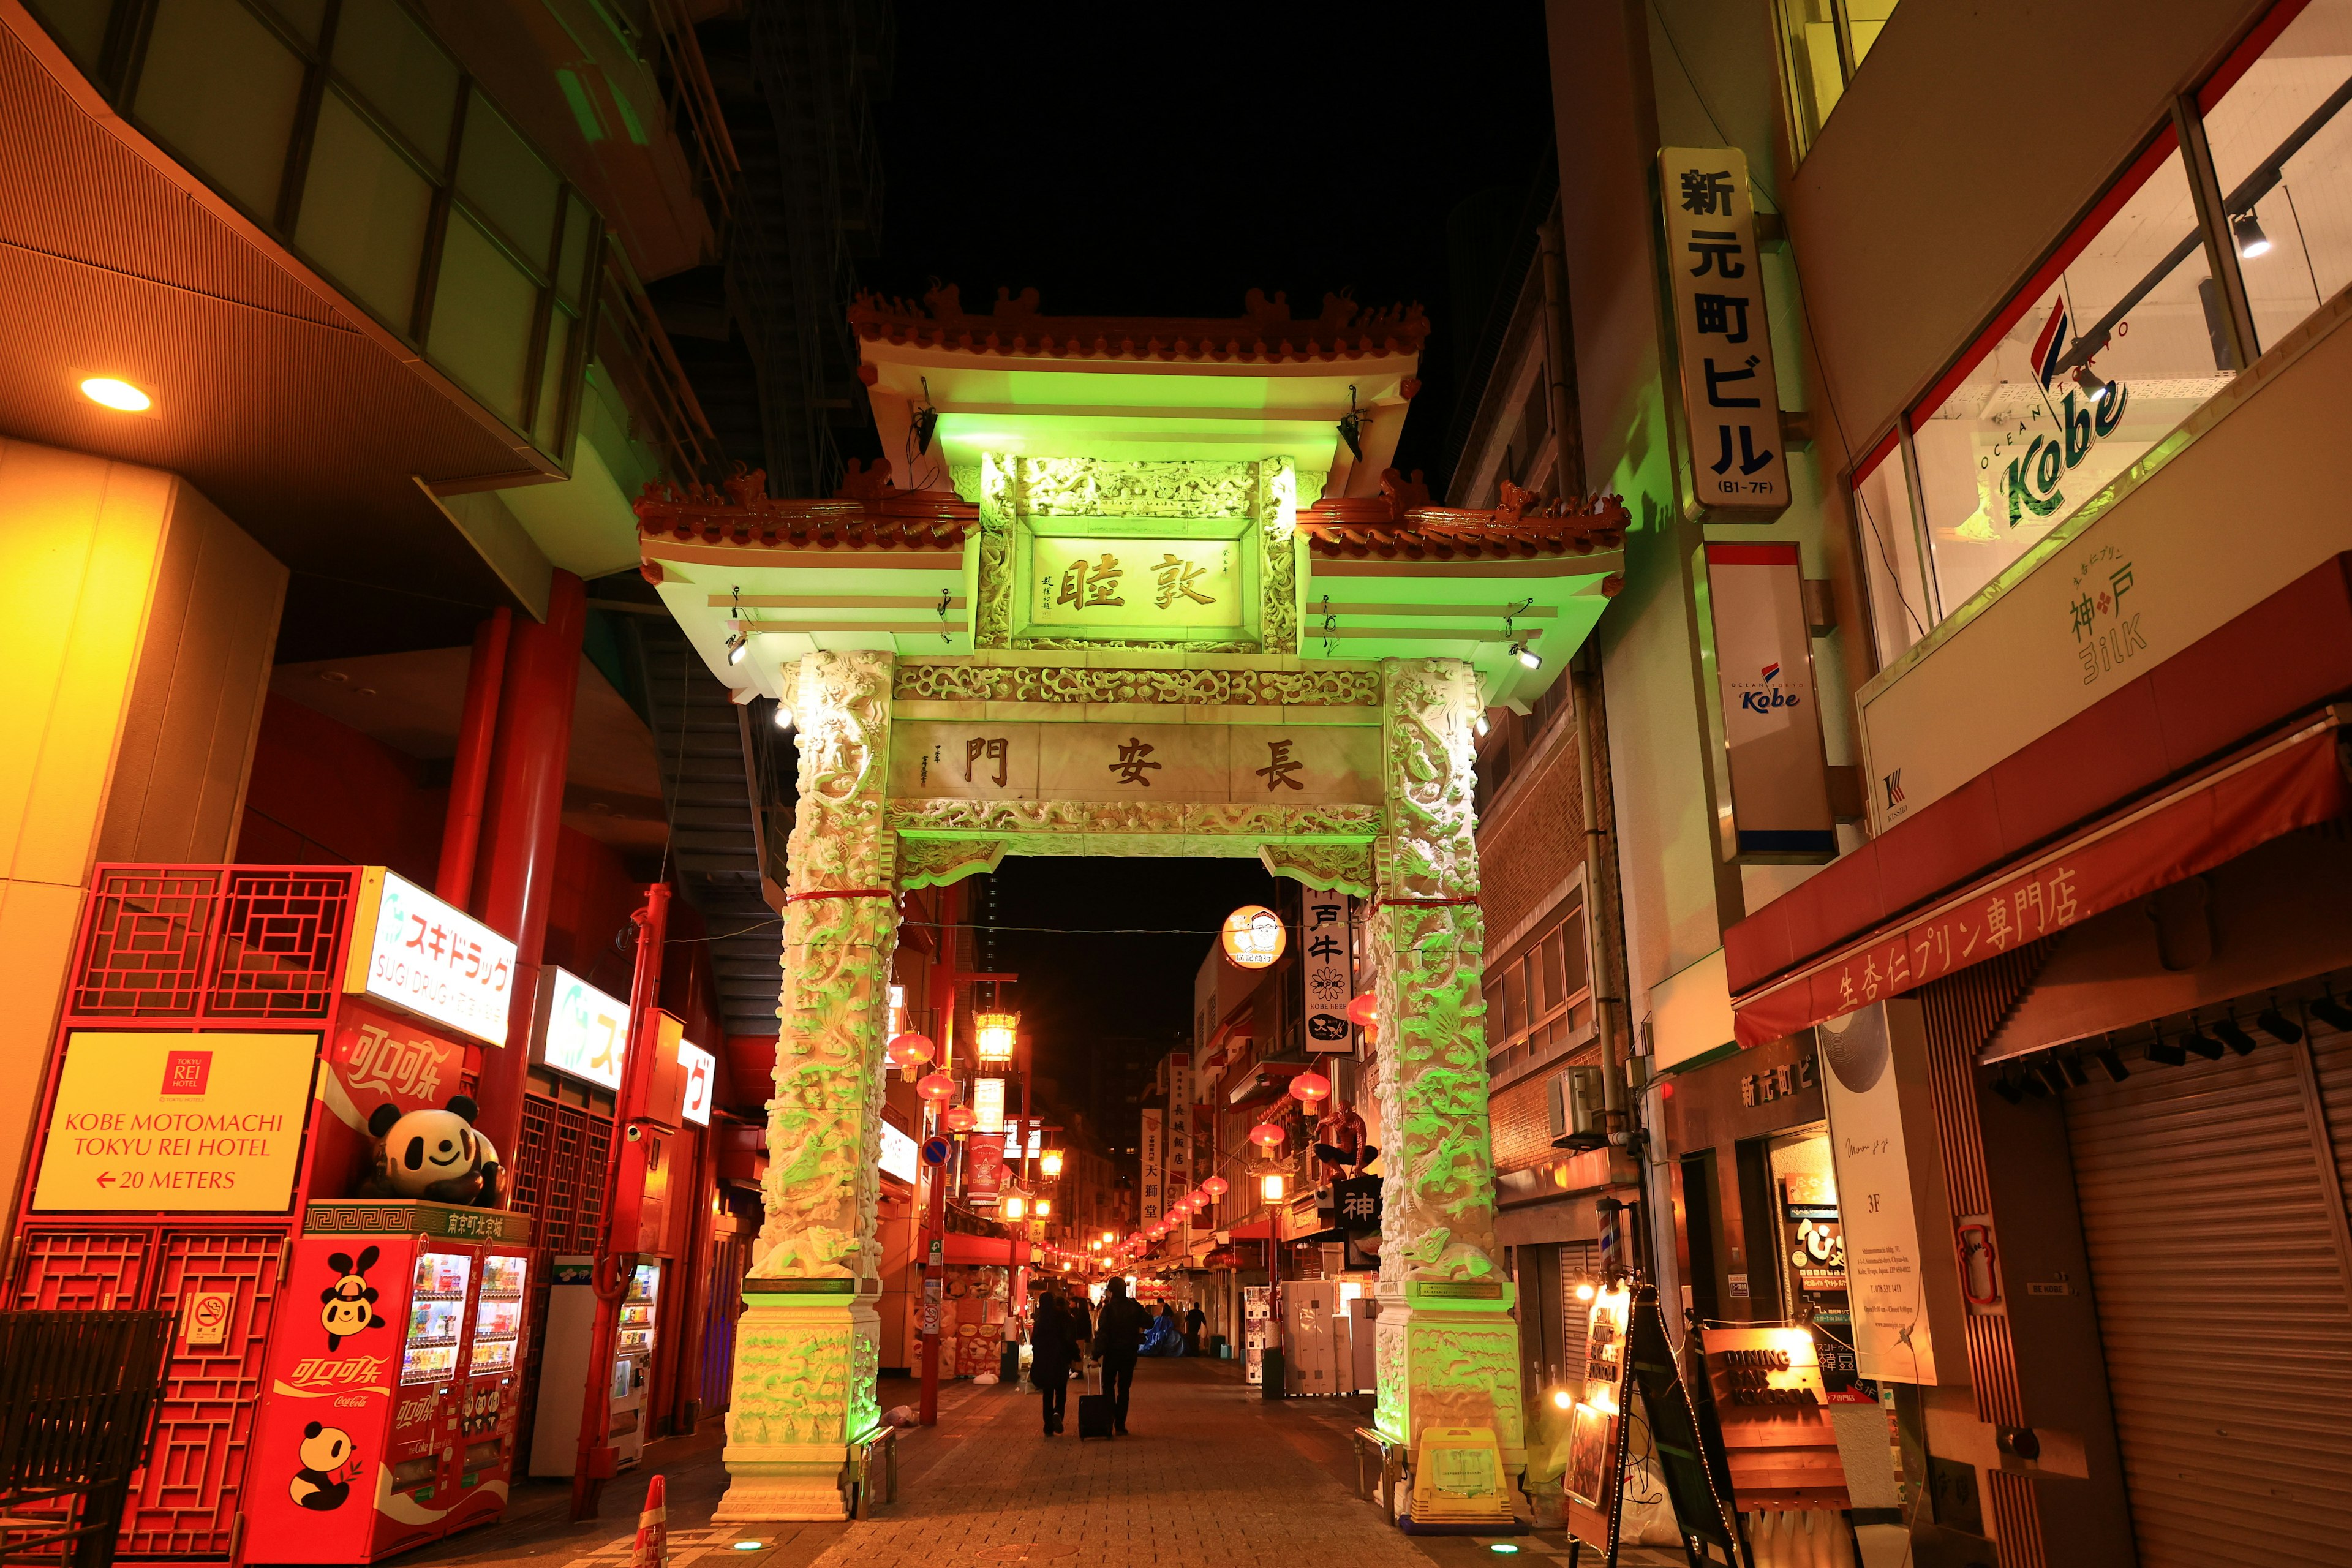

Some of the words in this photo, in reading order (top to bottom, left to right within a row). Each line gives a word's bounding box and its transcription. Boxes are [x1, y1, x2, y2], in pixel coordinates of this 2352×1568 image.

[1681, 168, 1774, 475] 新元町ビル
[1981, 405, 2041, 470] OCEAN
[2057, 322, 2128, 396] TOKYO
[2000, 380, 2128, 529] Kobe
[1718, 480, 1773, 494] (B1-7F)
[2070, 562, 2134, 644] 神戸
[1740, 688, 1800, 714] Kobe
[1888, 805, 1907, 822] KISSHO
[1832, 867, 2078, 1011] 生杏仁プリン専門店
[405, 914, 511, 992] スギドラッグ
[376, 954, 410, 989] SUGI
[412, 970, 447, 1011] DRUG
[173, 1066, 200, 1079] REI
[347, 1023, 451, 1102] 可口可乐
[65, 1114, 126, 1131] KOBE
[130, 1114, 283, 1132] MOTOMACHI
[74, 1138, 153, 1156] TOKYU
[158, 1139, 191, 1156] REI
[198, 1139, 271, 1156] HOTEL
[119, 1172, 144, 1189] 20
[149, 1172, 235, 1189] METERS
[1868, 1194, 1880, 1213] 3F
[448, 1213, 503, 1237] 南京町北京城
[1724, 1349, 1791, 1366] DINING
[291, 1355, 390, 1387] 可口可乐
[1727, 1368, 1770, 1388] BAR
[1854, 1379, 1877, 1397] B1F
[415, 1442, 429, 1453] Coke
